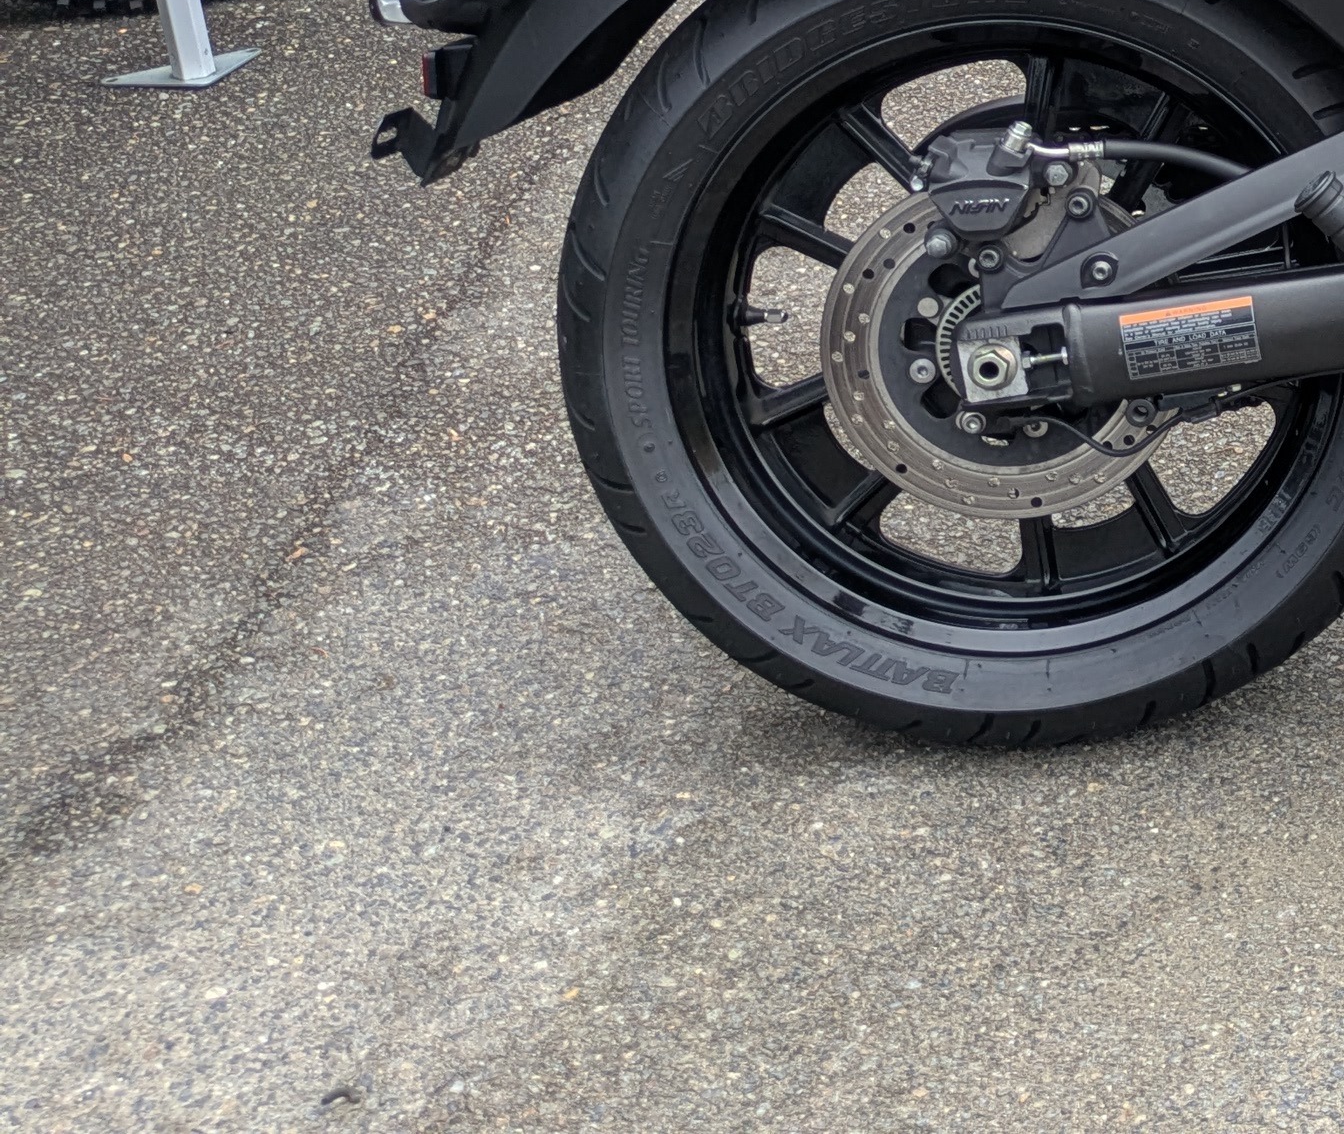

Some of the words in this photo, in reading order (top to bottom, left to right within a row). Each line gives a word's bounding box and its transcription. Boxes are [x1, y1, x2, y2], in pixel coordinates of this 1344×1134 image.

[621, 246, 650, 347] TOURING
[1172, 335, 1186, 343] AND
[1188, 332, 1207, 342] LOAD
[1209, 330, 1227, 338] DATA
[622, 355, 652, 429] SPORT
[778, 614, 961, 694] BATTLAX
